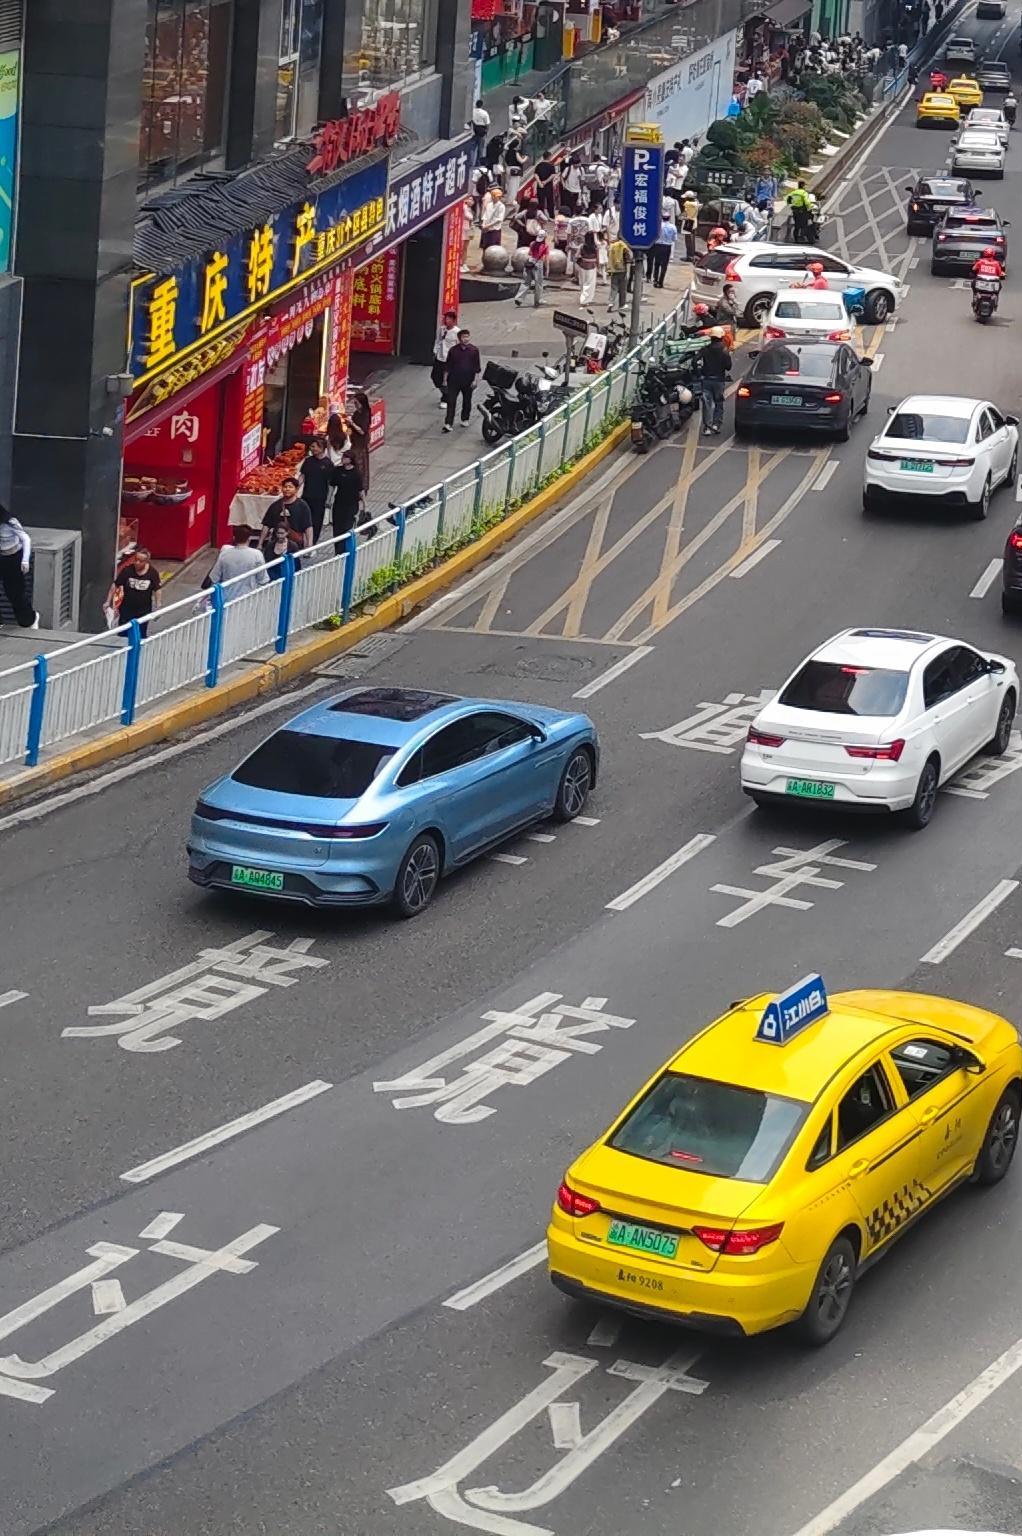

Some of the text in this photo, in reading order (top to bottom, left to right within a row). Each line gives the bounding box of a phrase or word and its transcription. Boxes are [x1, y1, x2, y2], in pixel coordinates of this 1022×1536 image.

[633, 149, 650, 171] P
[372, 151, 468, 247] 庆烟酒特产超市
[632, 173, 649, 237] 宏福俊悦
[147, 201, 316, 368] 重庆特产
[170, 411, 200, 443] 肉
[783, 990, 823, 1031] 江小白
[638, 1275, 664, 1291] 9208
